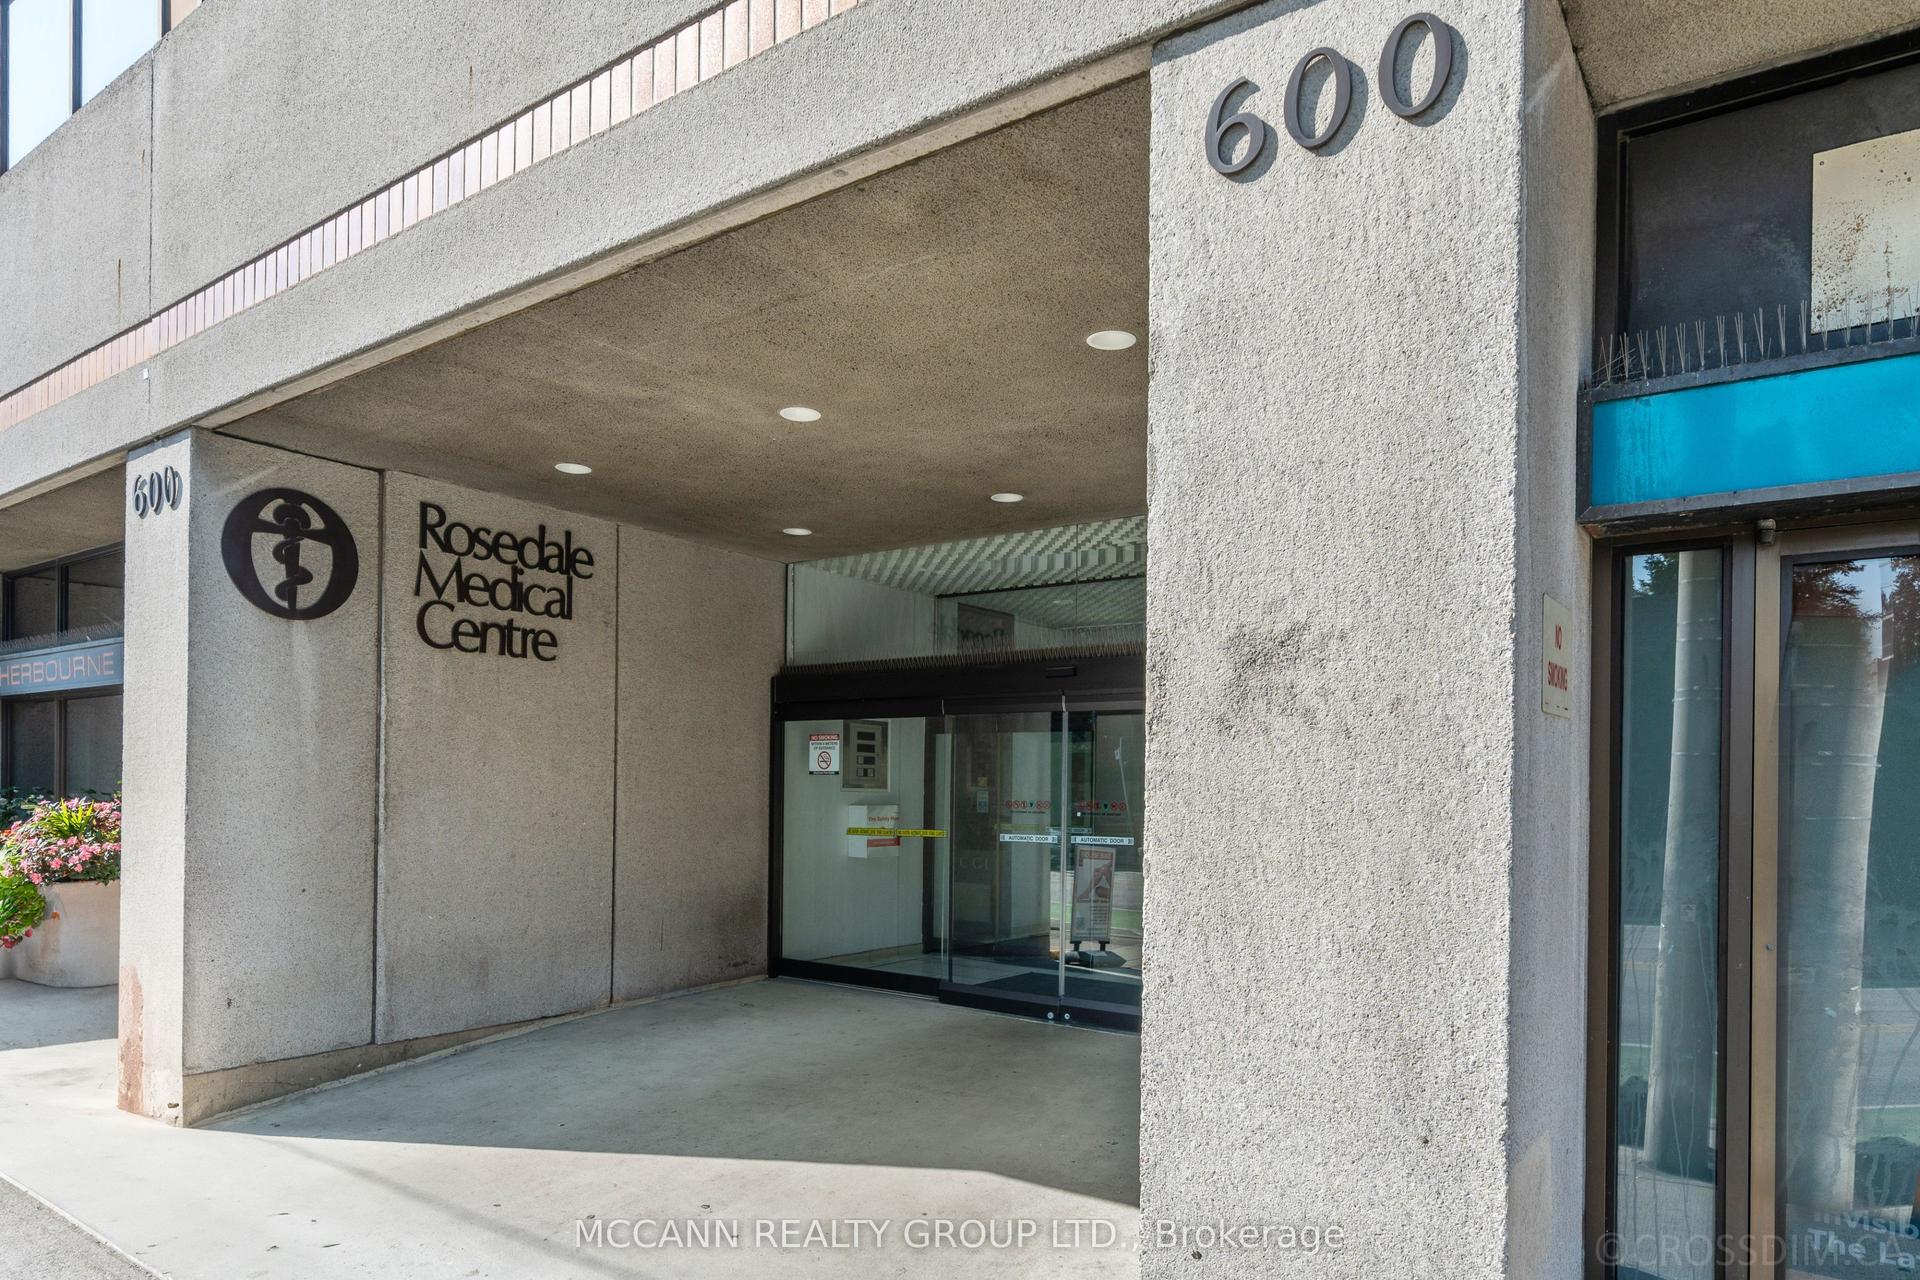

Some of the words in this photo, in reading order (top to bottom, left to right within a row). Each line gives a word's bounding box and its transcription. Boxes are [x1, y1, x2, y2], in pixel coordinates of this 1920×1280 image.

[1205, 12, 1453, 174] 600
[134, 465, 181, 518] 600
[419, 501, 594, 579] Rosedale
[414, 549, 573, 620] Medical
[416, 600, 558, 661] Centre
[1554, 623, 1562, 651] NO
[1807, 1228, 1867, 1261] The
